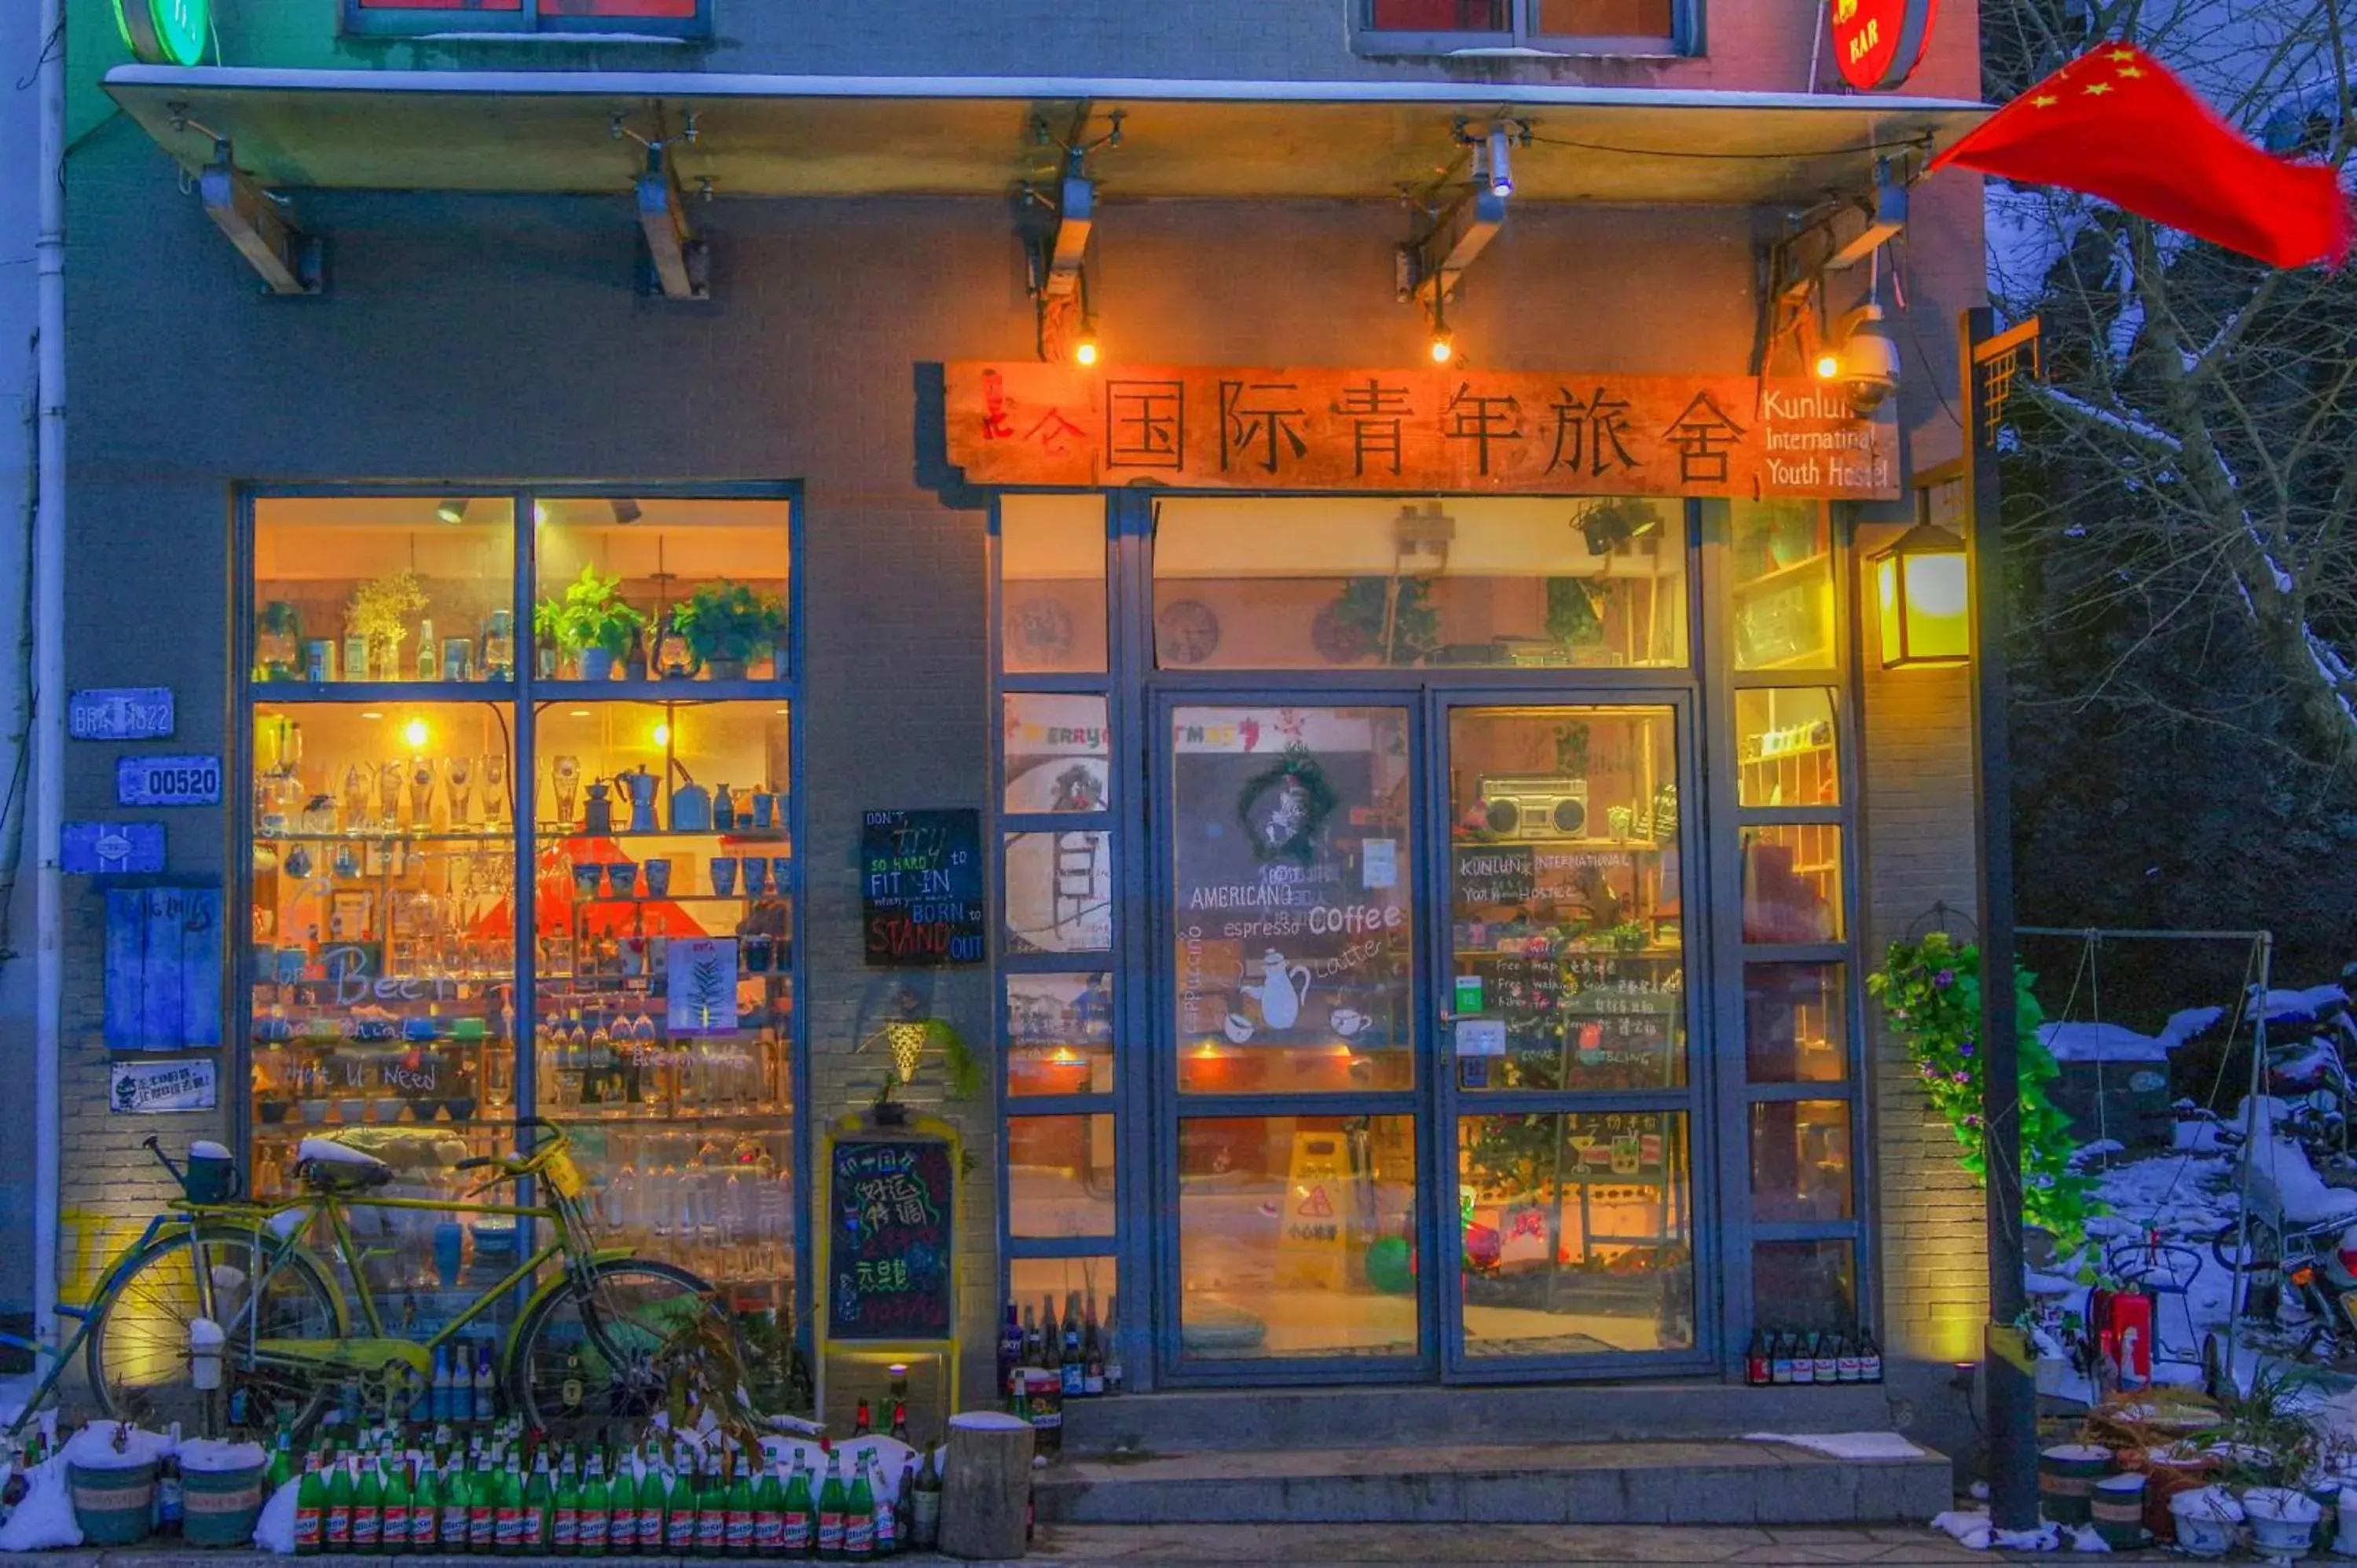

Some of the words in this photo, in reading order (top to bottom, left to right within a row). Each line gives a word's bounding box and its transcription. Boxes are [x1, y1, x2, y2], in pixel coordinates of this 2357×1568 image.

[1849, 17, 1879, 65] BAR
[1766, 457, 1820, 485] Youth
[1829, 457, 1888, 489] Hostel
[149, 769, 216, 795] 00520
[893, 856, 927, 870] HARD
[871, 871, 901, 896] FIT
[922, 869, 951, 893] IN
[1190, 884, 1292, 911] AMERICANO
[912, 903, 963, 924] BORN
[1309, 903, 1402, 935] Coffee
[871, 917, 948, 957] STAND
[951, 935, 982, 958] OUT
[1223, 921, 1299, 939] espresso
[321, 945, 449, 1006] Beer
[346, 1062, 364, 1088] U
[383, 1062, 436, 1090] Need
